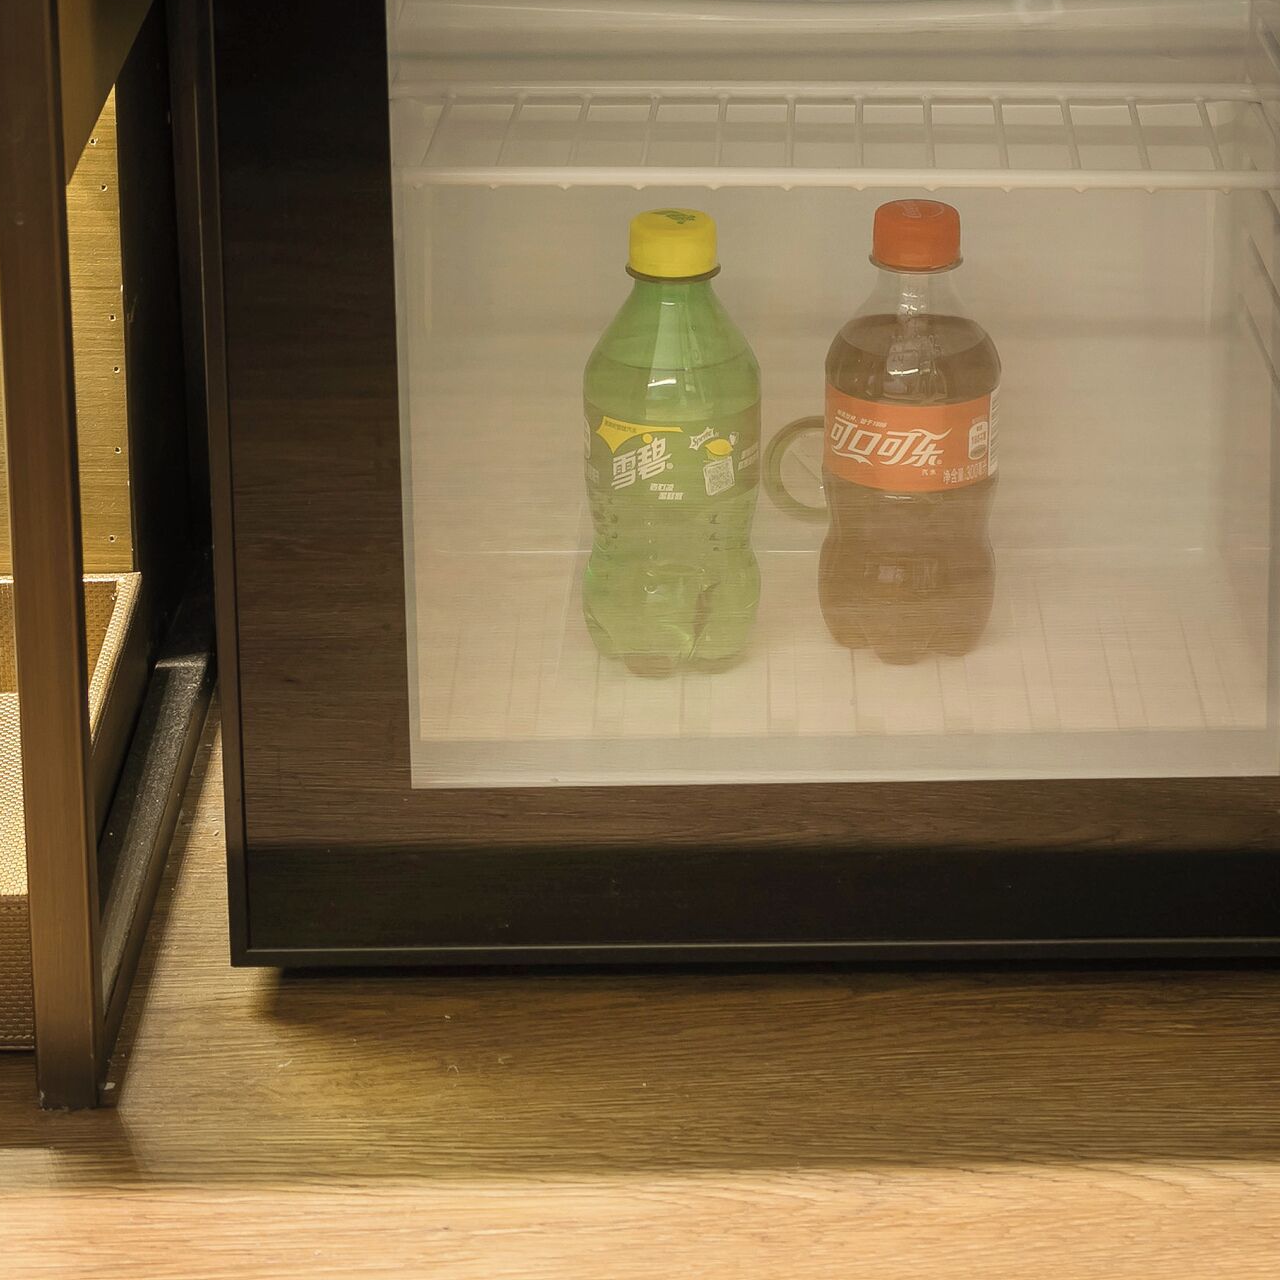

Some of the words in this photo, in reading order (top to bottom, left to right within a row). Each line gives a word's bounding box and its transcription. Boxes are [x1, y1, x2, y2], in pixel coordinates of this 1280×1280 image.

[611, 437, 672, 490] 雪碧
[830, 416, 952, 467] 可口可乐
